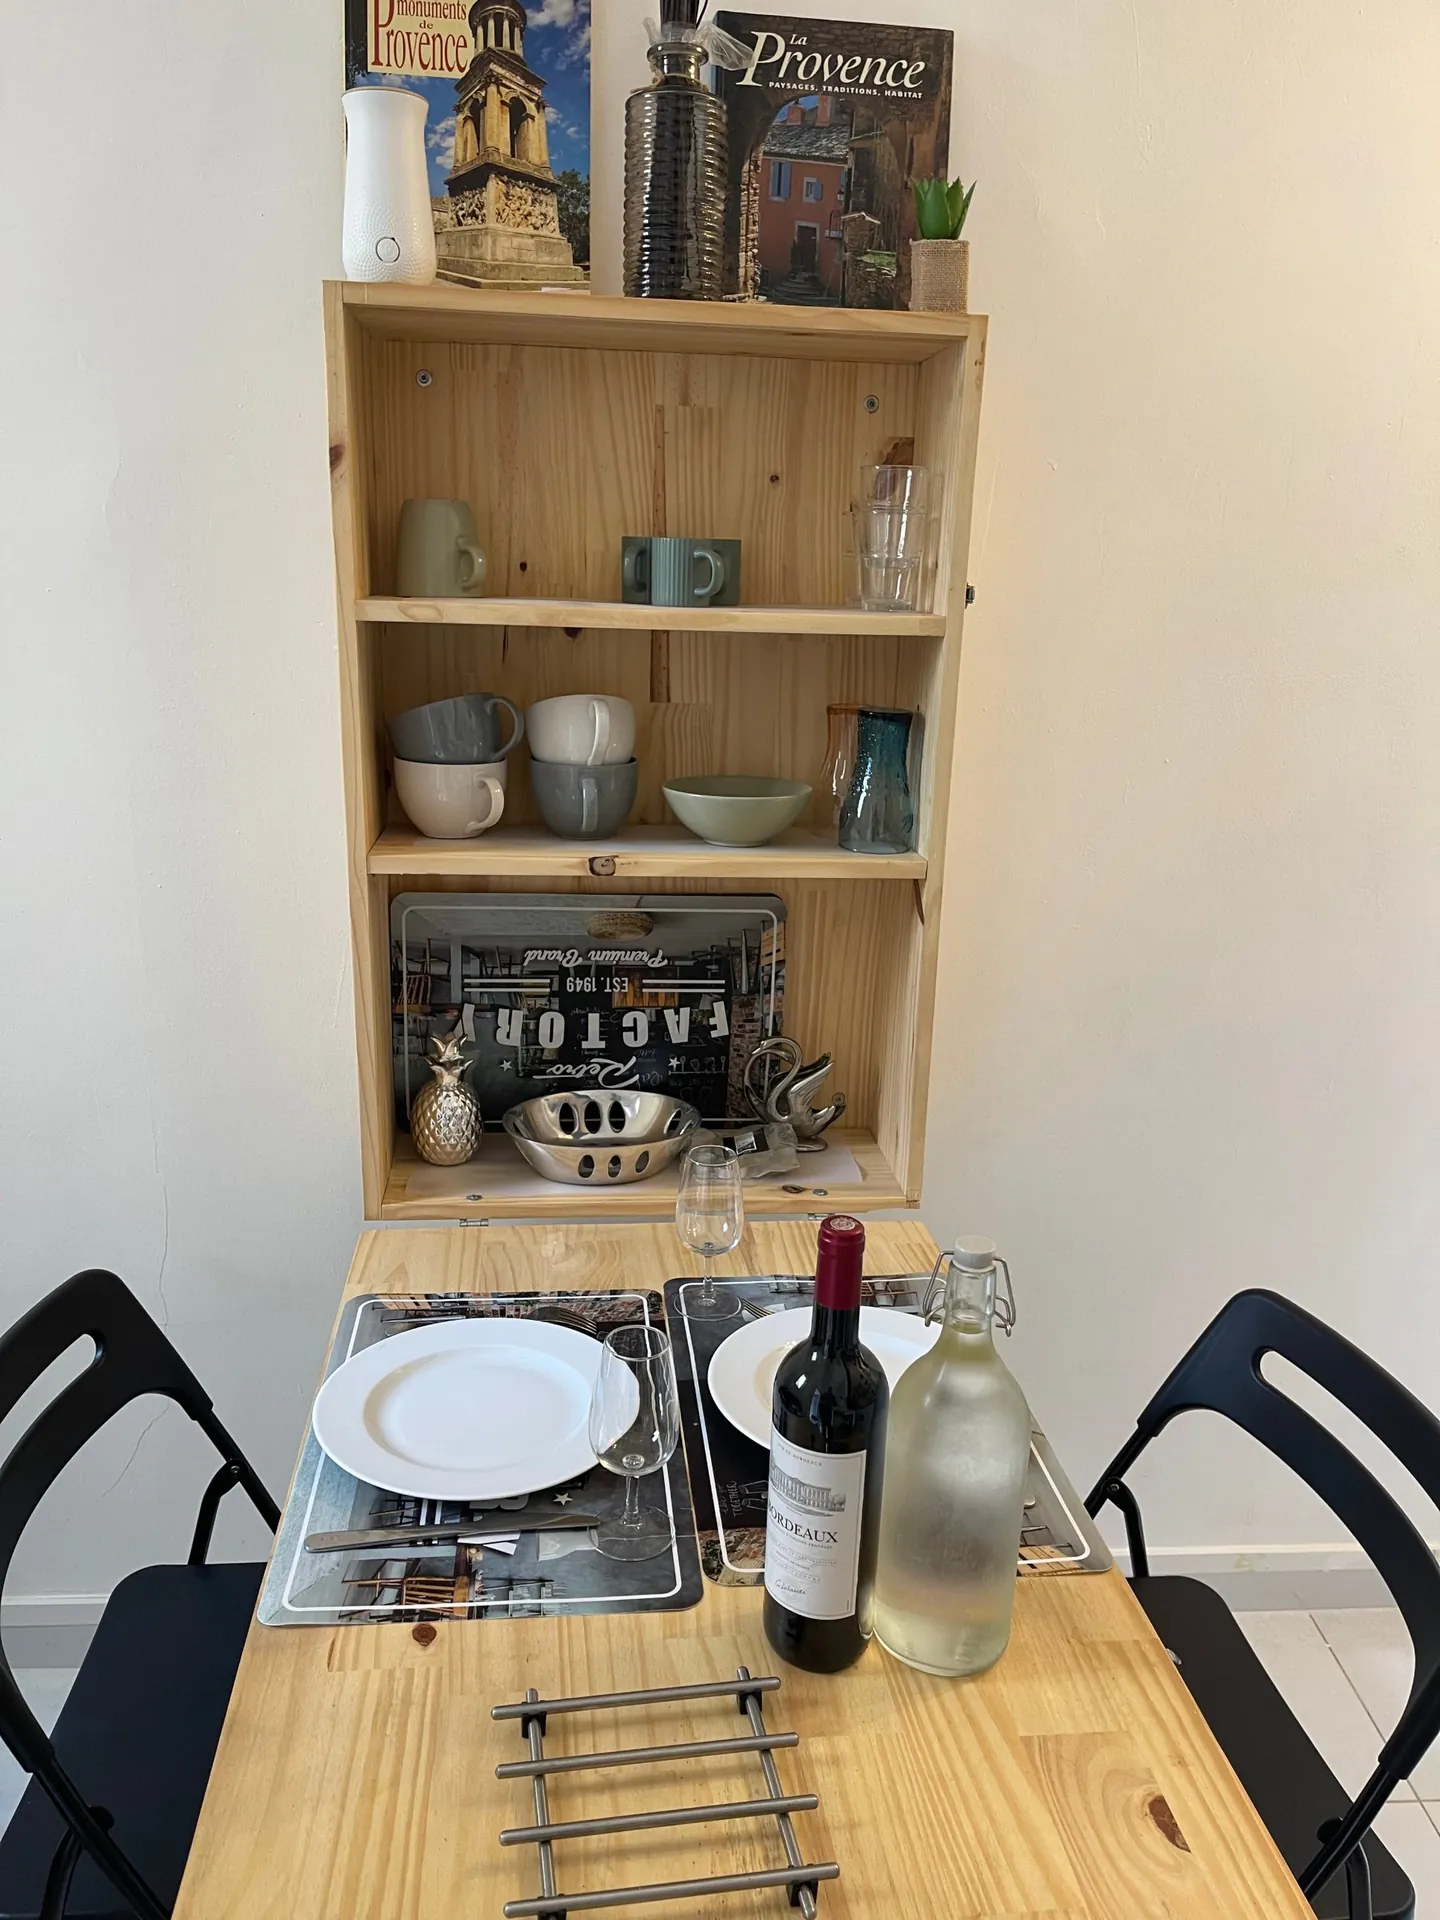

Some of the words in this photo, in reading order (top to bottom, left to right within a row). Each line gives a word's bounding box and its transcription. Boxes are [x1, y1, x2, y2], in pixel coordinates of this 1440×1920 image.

[396, 0, 467, 21] monuments
[419, 20, 434, 30] de
[371, 0, 468, 73] Provence
[790, 34, 808, 46] La
[735, 31, 926, 88] Provence
[884, 90, 923, 99] HABITAT
[522, 948, 582, 968] Brand
[587, 948, 669, 968] Premium
[566, 977, 597, 992] 1949
[452, 1000, 729, 1049] FACTORY
[533, 1056, 640, 1088] Retro
